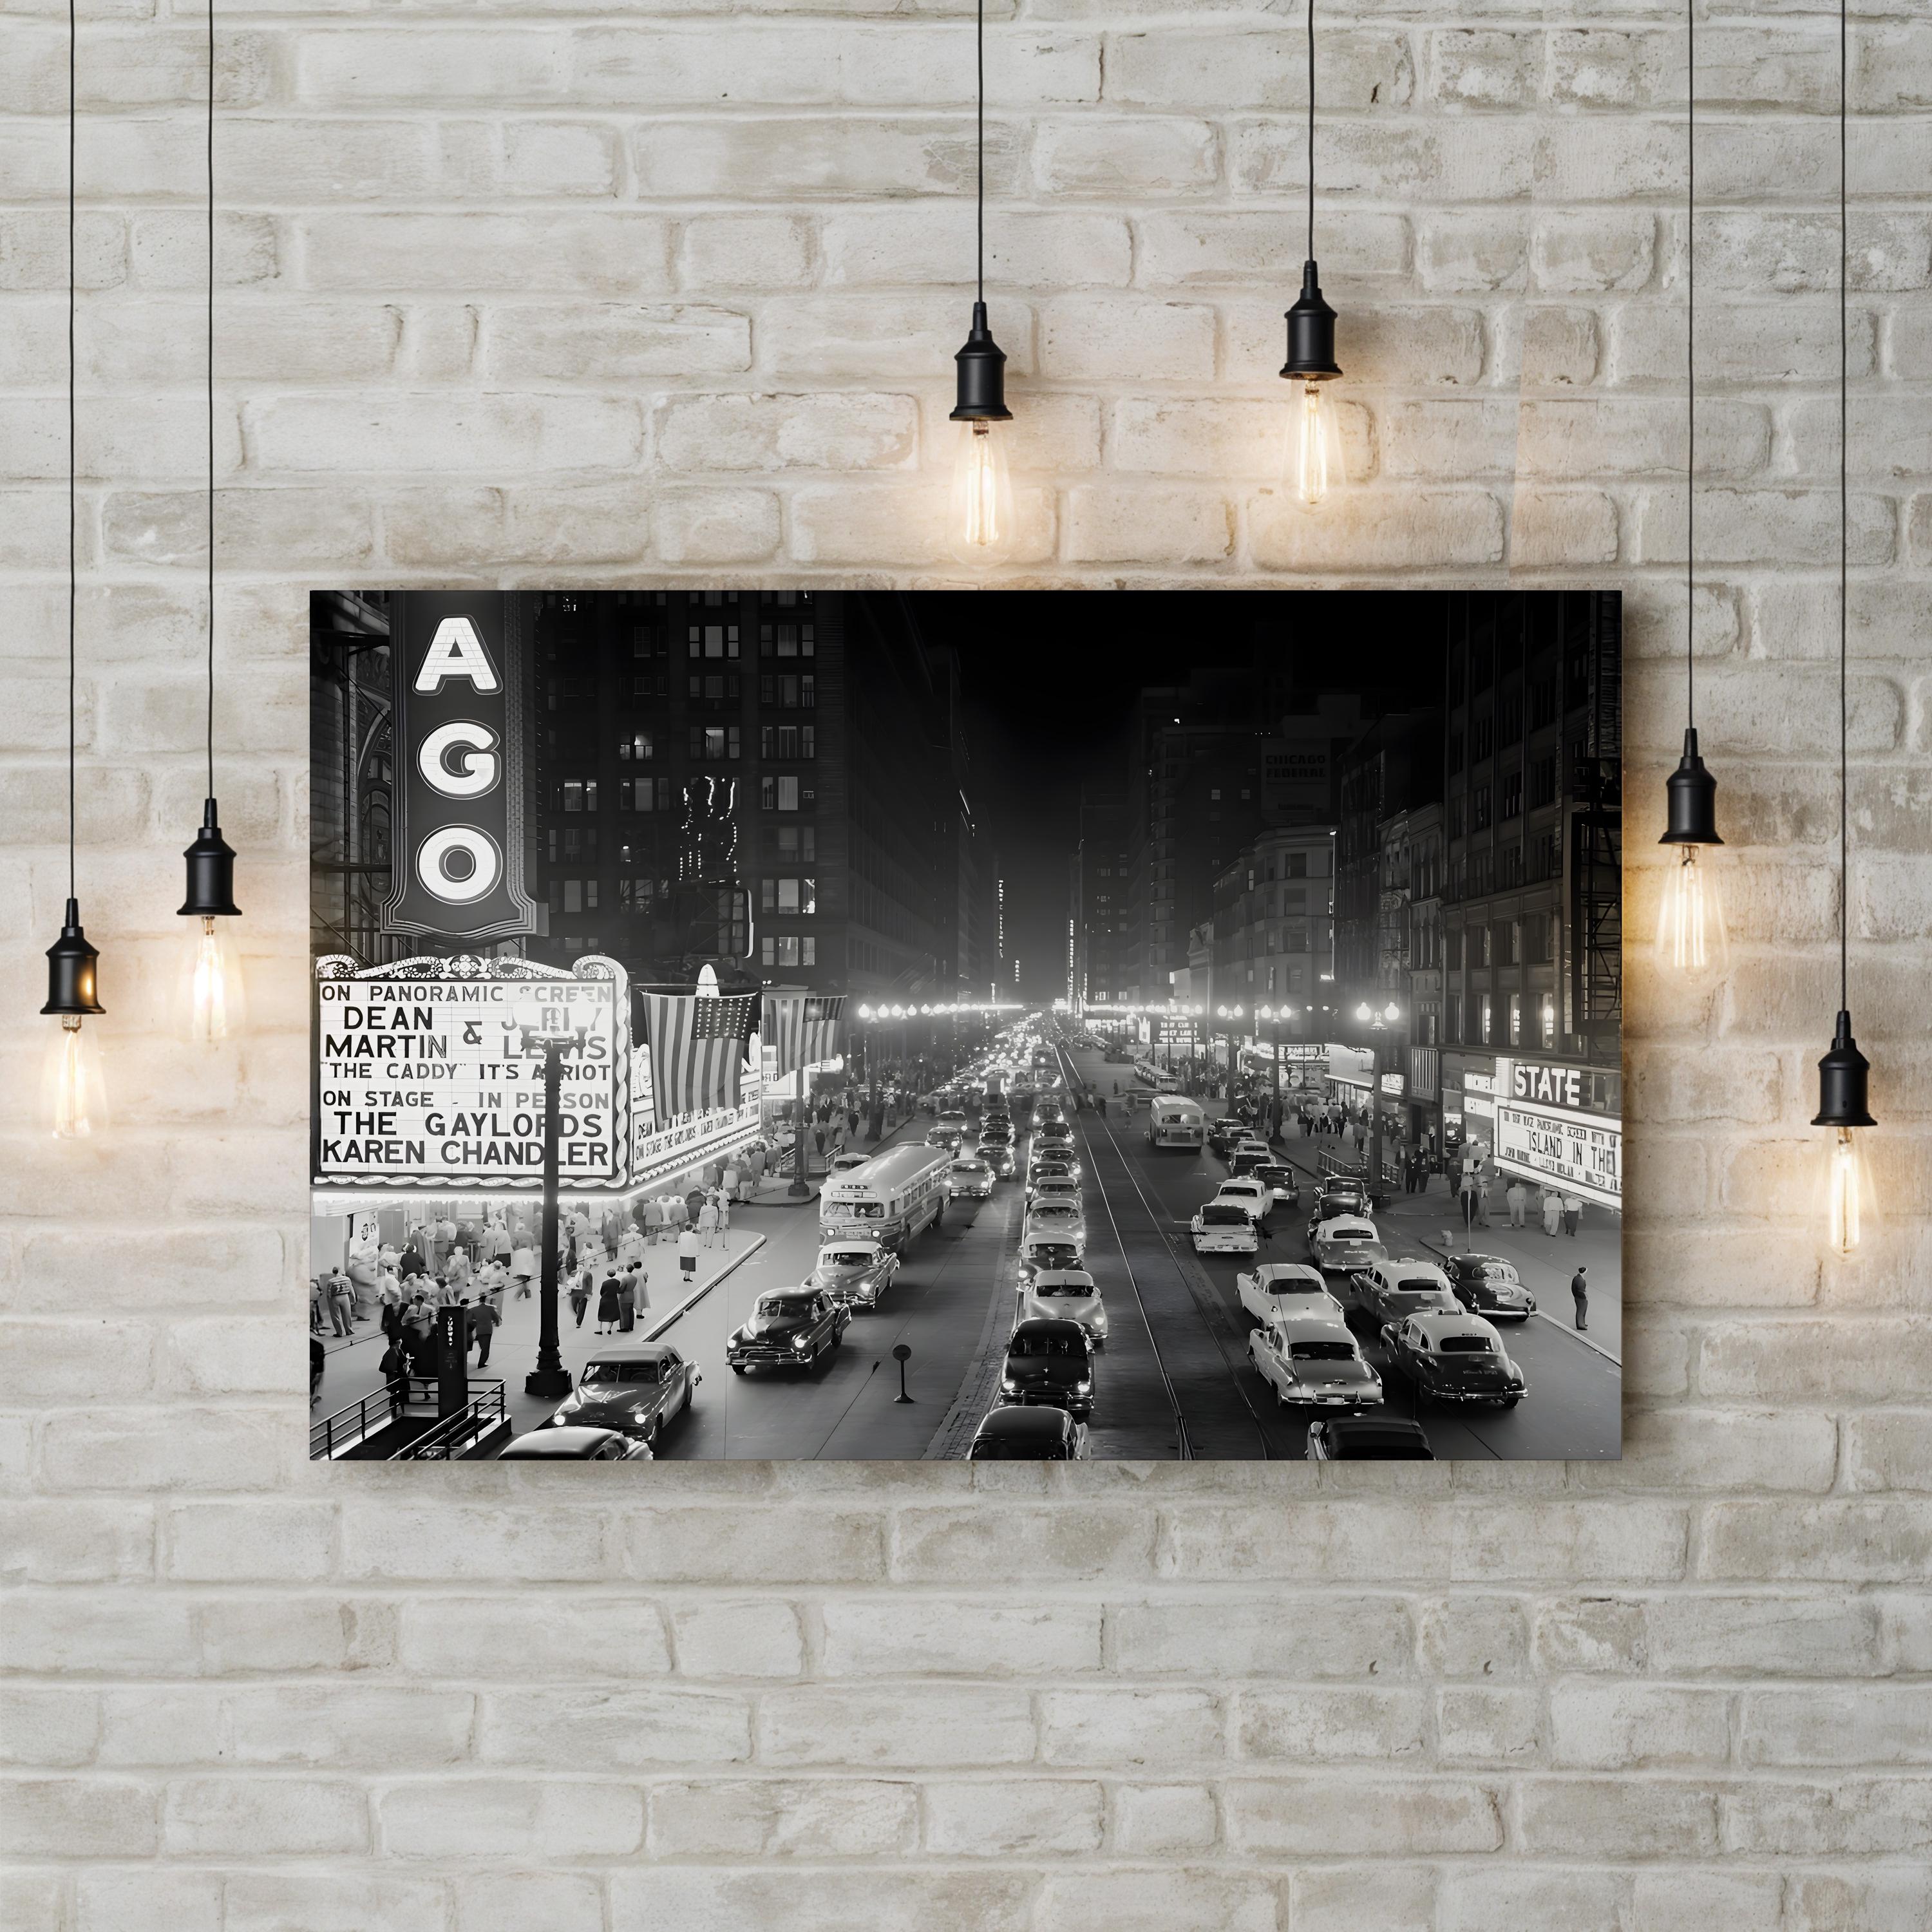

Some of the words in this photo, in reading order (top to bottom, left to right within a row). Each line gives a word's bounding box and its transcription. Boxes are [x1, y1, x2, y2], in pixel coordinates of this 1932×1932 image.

[414, 616, 500, 902] AGO
[322, 985, 350, 1001] ON
[370, 985, 504, 1001] PANORAMIC
[344, 1006, 432, 1030] DEAN
[463, 1021, 482, 1045] &
[326, 1034, 447, 1058] MARTIN
[480, 1064, 519, 1079] IT'S
[531, 1065, 545, 1080] A
[560, 1064, 611, 1080] RIOT
[1515, 1065, 1580, 1106] STATE
[323, 1090, 350, 1106] ON
[365, 1091, 433, 1107] STAGE
[479, 1092, 501, 1108] IN
[516, 1092, 609, 1109] PESON
[334, 1112, 397, 1135] THE
[323, 1139, 424, 1164] KAREN
[440, 1141, 608, 1166] CHANDER
[1573, 1142, 1582, 1166] IN
